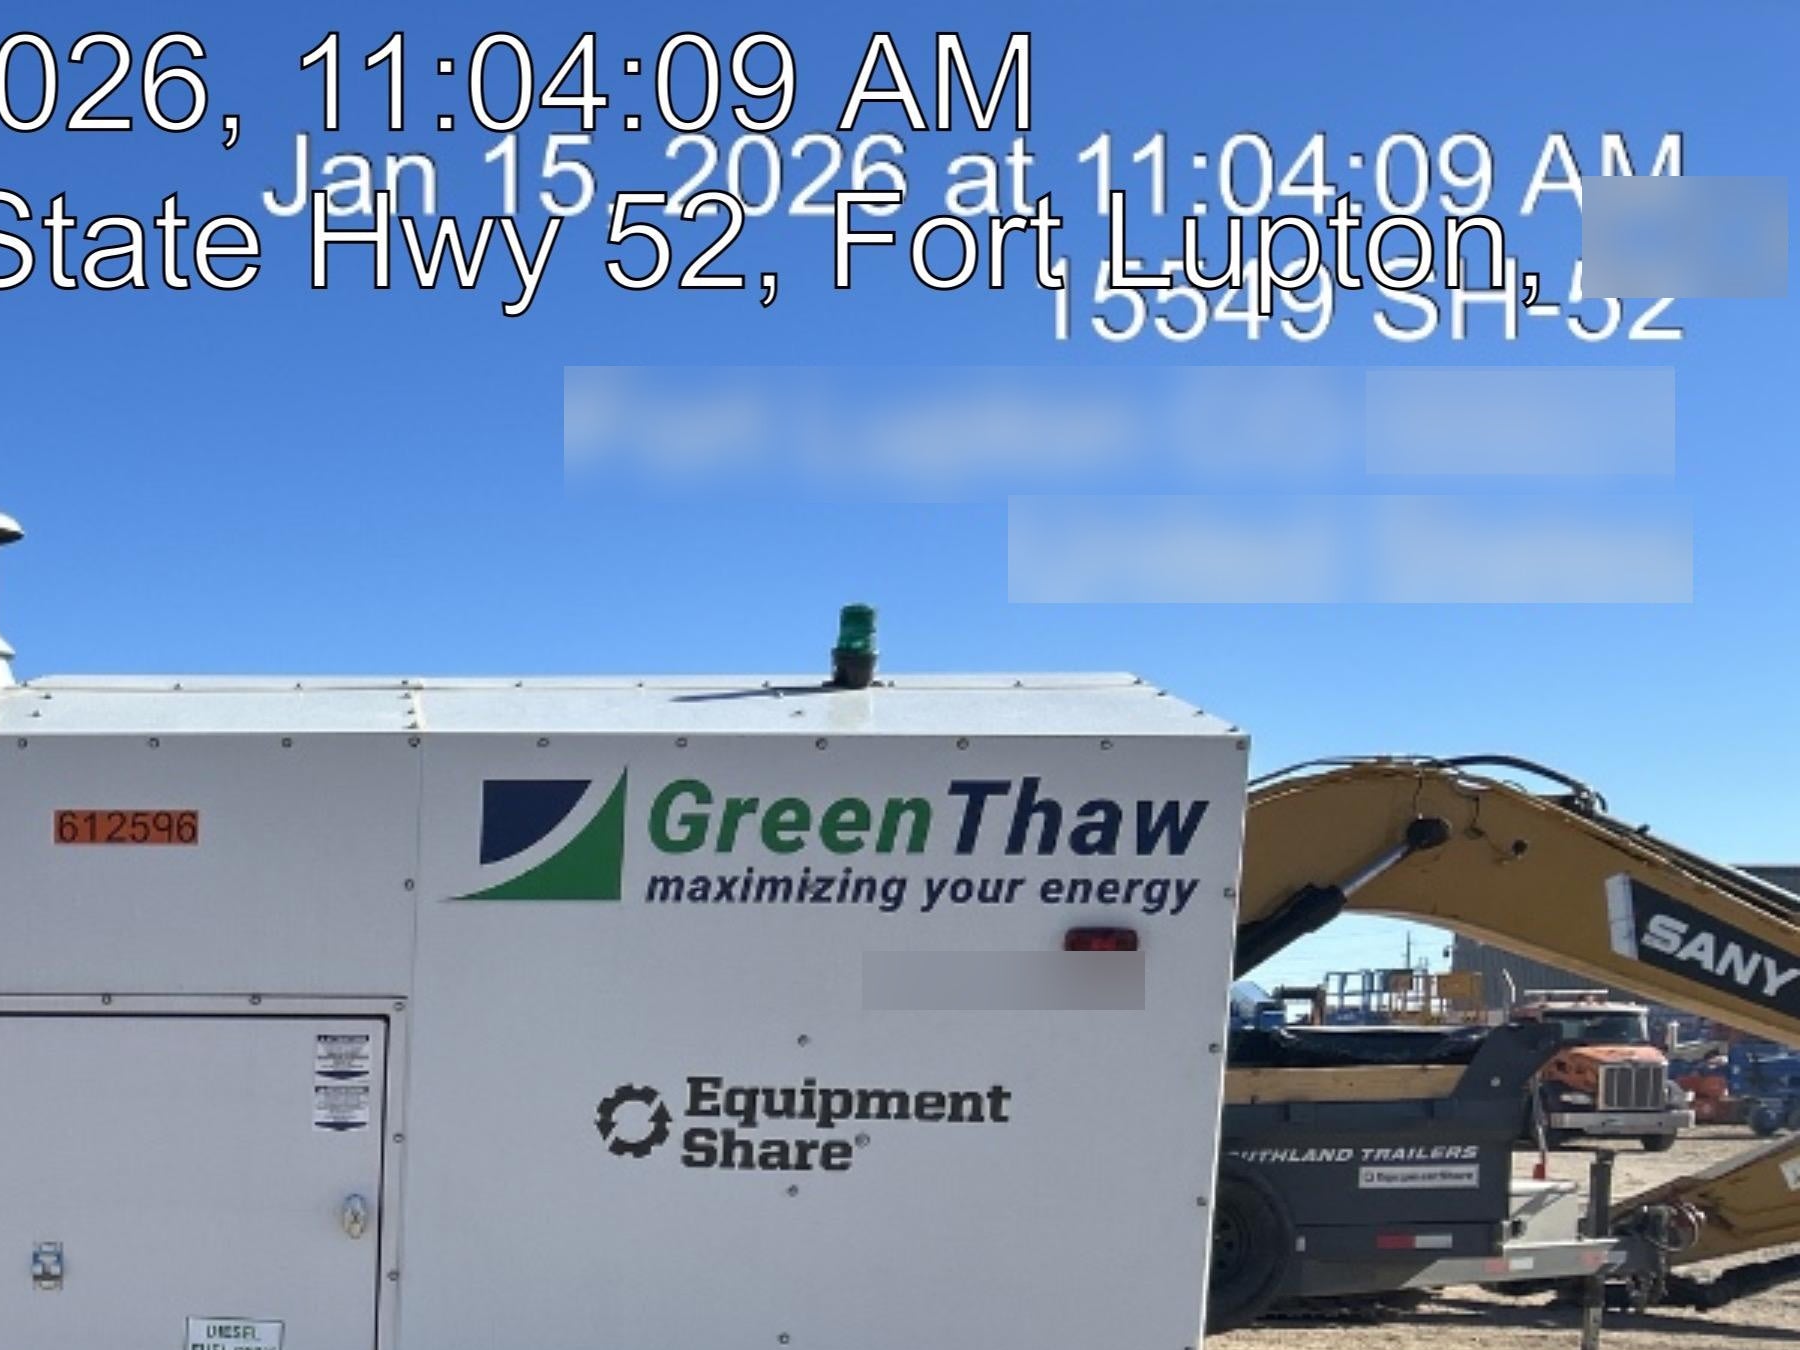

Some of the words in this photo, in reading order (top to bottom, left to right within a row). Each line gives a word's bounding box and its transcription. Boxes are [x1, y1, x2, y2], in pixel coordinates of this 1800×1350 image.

[58, 809, 196, 844] 612596
[648, 778, 1209, 856] GreenThaw
[646, 866, 908, 912] maximizing
[920, 873, 1026, 913] your
[1038, 873, 1199, 914] energy
[1641, 914, 1800, 997] SANY
[686, 1076, 1011, 1128] Equipment
[682, 1128, 852, 1171] Share
[1228, 1148, 1354, 1163] UTHLAND
[1361, 1145, 1480, 1162] TRAILERS
